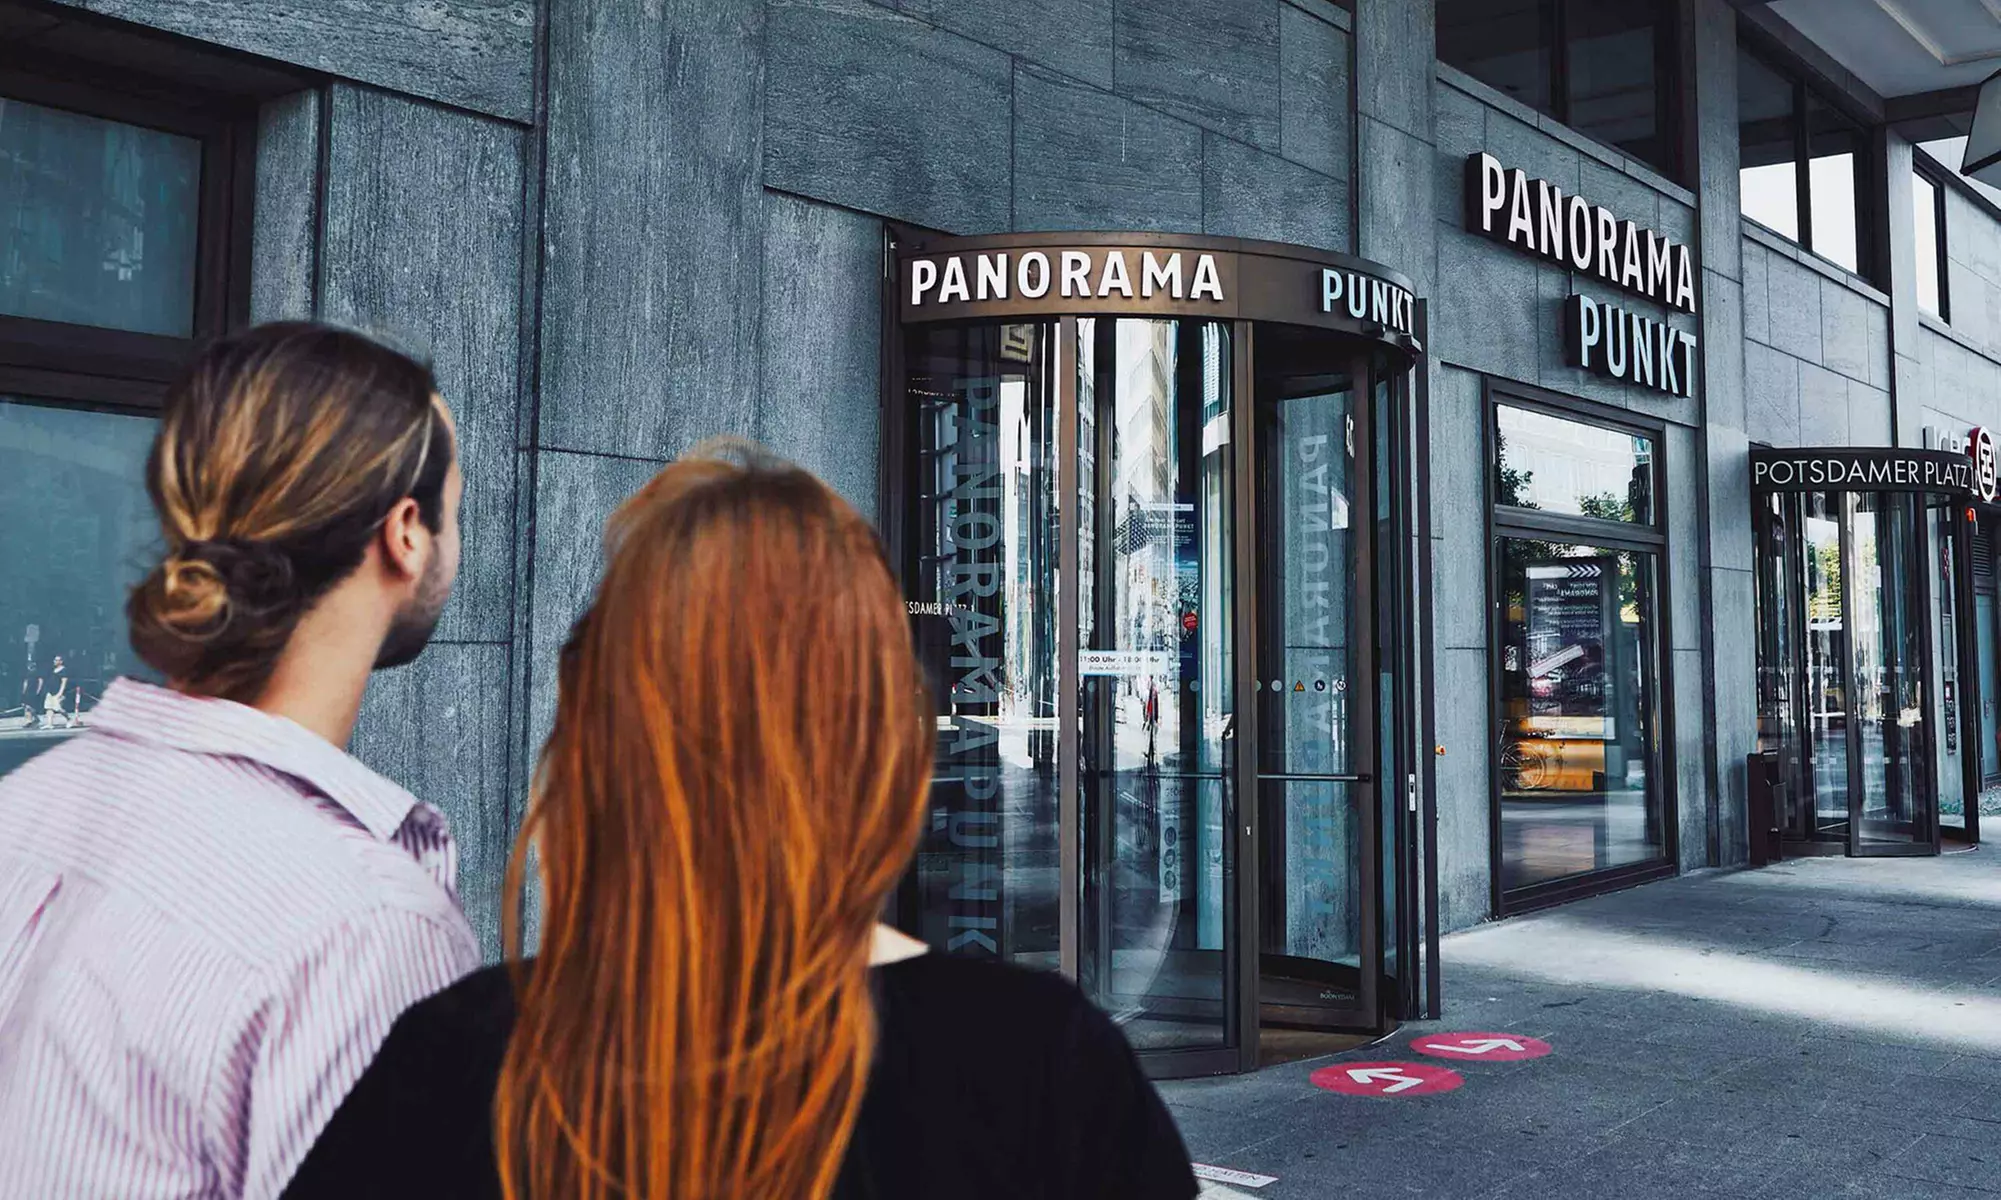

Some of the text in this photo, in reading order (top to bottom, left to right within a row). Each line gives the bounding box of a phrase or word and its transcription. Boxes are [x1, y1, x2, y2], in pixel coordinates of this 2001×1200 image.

[1482, 152, 1695, 313] PANORAMA
[911, 251, 1415, 333] PANORAMA PUNKT
[1580, 295, 1696, 398] PUNKT
[1755, 459, 1920, 484] POTSDAMER
[1925, 461, 1968, 488] PLATZ
[906, 601, 942, 615] SDAMER
